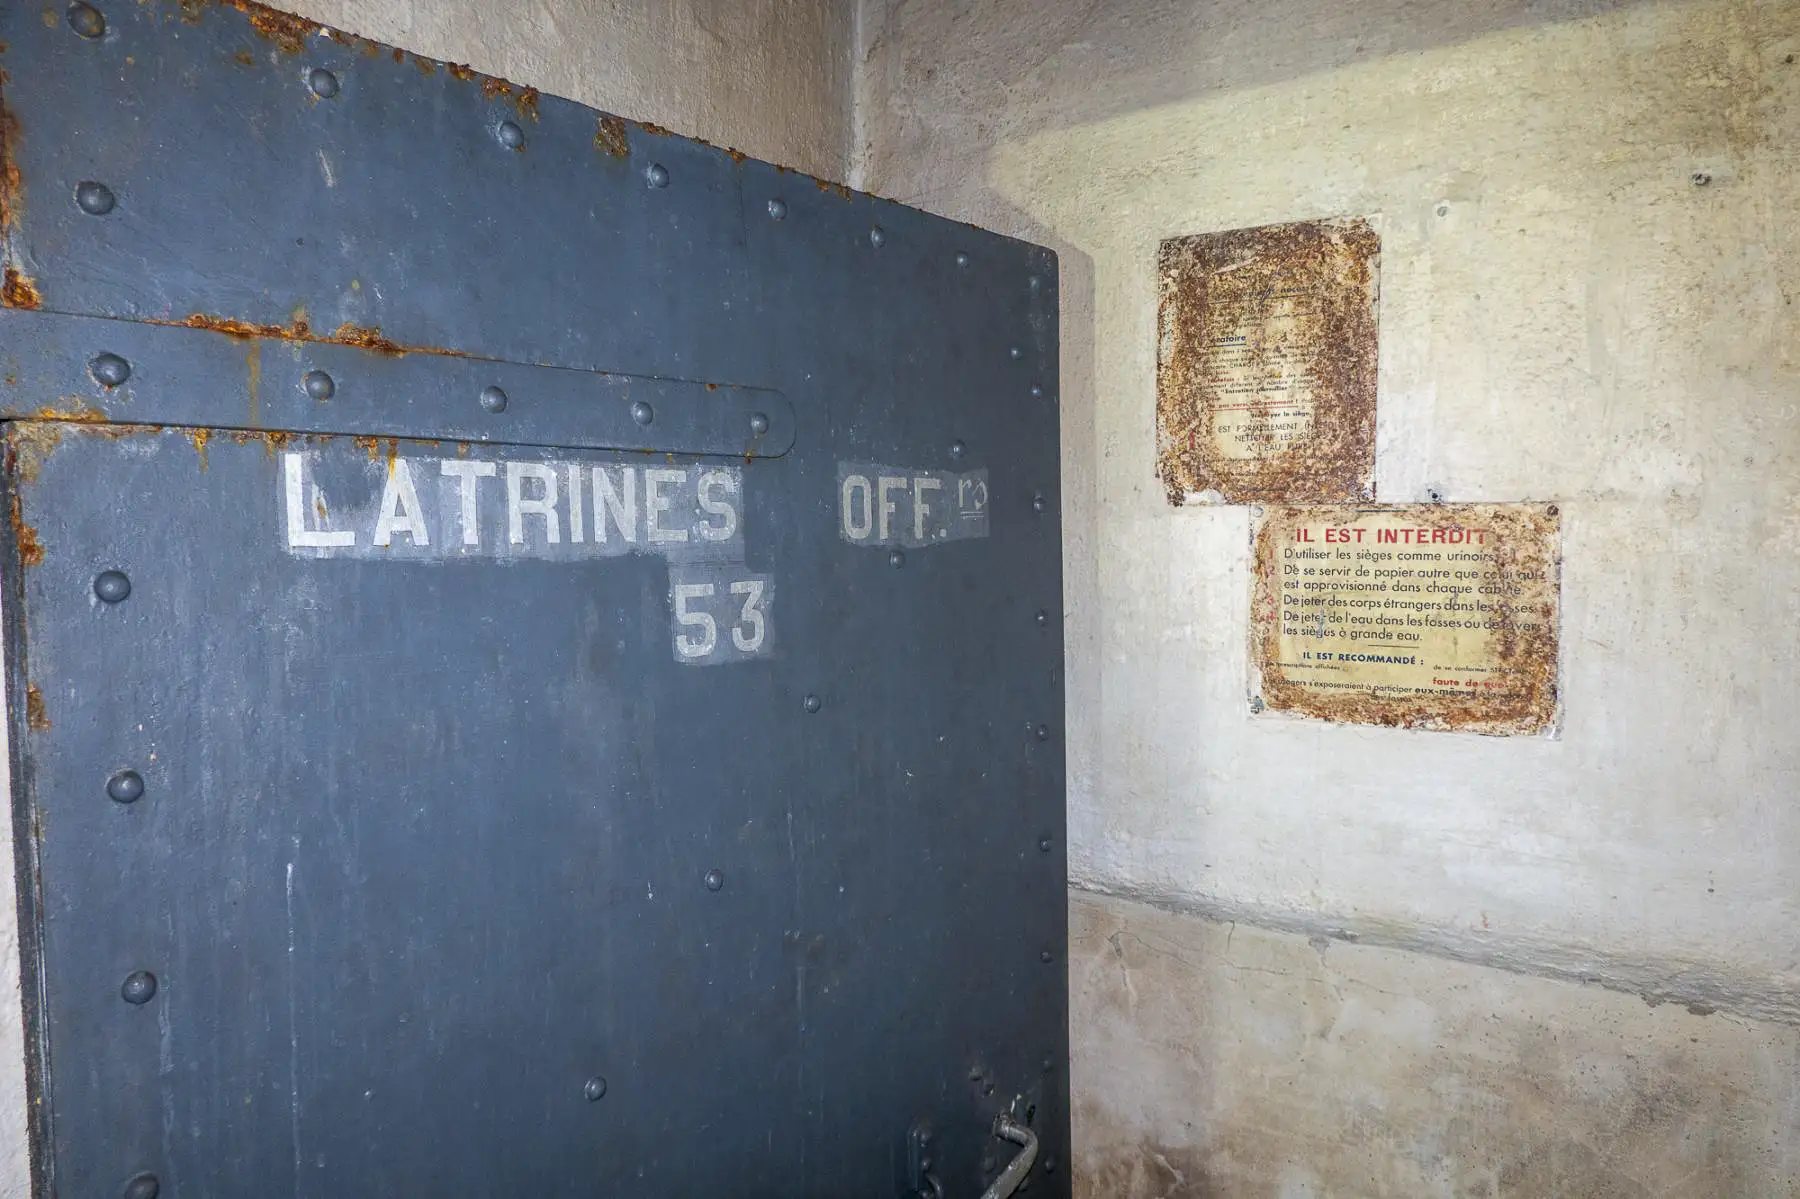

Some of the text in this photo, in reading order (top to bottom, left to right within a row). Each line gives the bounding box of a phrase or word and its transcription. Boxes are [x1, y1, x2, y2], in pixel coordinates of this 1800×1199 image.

[1211, 334, 1246, 344] ratoire
[284, 453, 740, 547] LATRINES
[1296, 528, 1488, 545] IL EST INTERDIT
[1284, 547, 1332, 560] D'utiliser
[1336, 548, 1351, 560] les
[1356, 550, 1392, 562] sièges
[1397, 551, 1442, 561] comme
[1303, 567, 1316, 576] se
[1319, 567, 1351, 576] servir
[1355, 565, 1370, 577] de
[1375, 566, 1414, 580] papier
[1417, 569, 1450, 580] autre
[1454, 571, 1479, 583] que
[1283, 580, 1299, 590] est
[1303, 580, 1387, 592] approvisionné
[1392, 580, 1421, 593] dans
[1425, 581, 1473, 597] chaque
[1283, 594, 1299, 606] De
[1301, 595, 1327, 608] jeter
[1327, 595, 1348, 607] des
[1349, 598, 1382, 610] corps
[1383, 597, 1442, 613] étrangers
[1443, 599, 1475, 612] dans
[1476, 599, 1494, 612] les
[1283, 610, 1299, 621] De
[1301, 611, 1327, 624] jeter
[1328, 611, 1343, 623] de
[1345, 613, 1373, 625] l'eau
[1375, 614, 1404, 626] dans
[1406, 615, 1422, 627] les
[1424, 615, 1461, 628] fosses
[1464, 620, 1481, 629] ou
[1283, 623, 1423, 641] les sièges à grande eau.
[1303, 651, 1312, 660] IL
[1317, 652, 1334, 661] EST
[1338, 653, 1416, 664] RECOMMANDÉ
[1309, 679, 1364, 690] s'exposeraient
[1365, 683, 1372, 691] à
[1373, 684, 1412, 694] participer
[1432, 676, 1460, 686] faute
[1465, 678, 1479, 688] de
